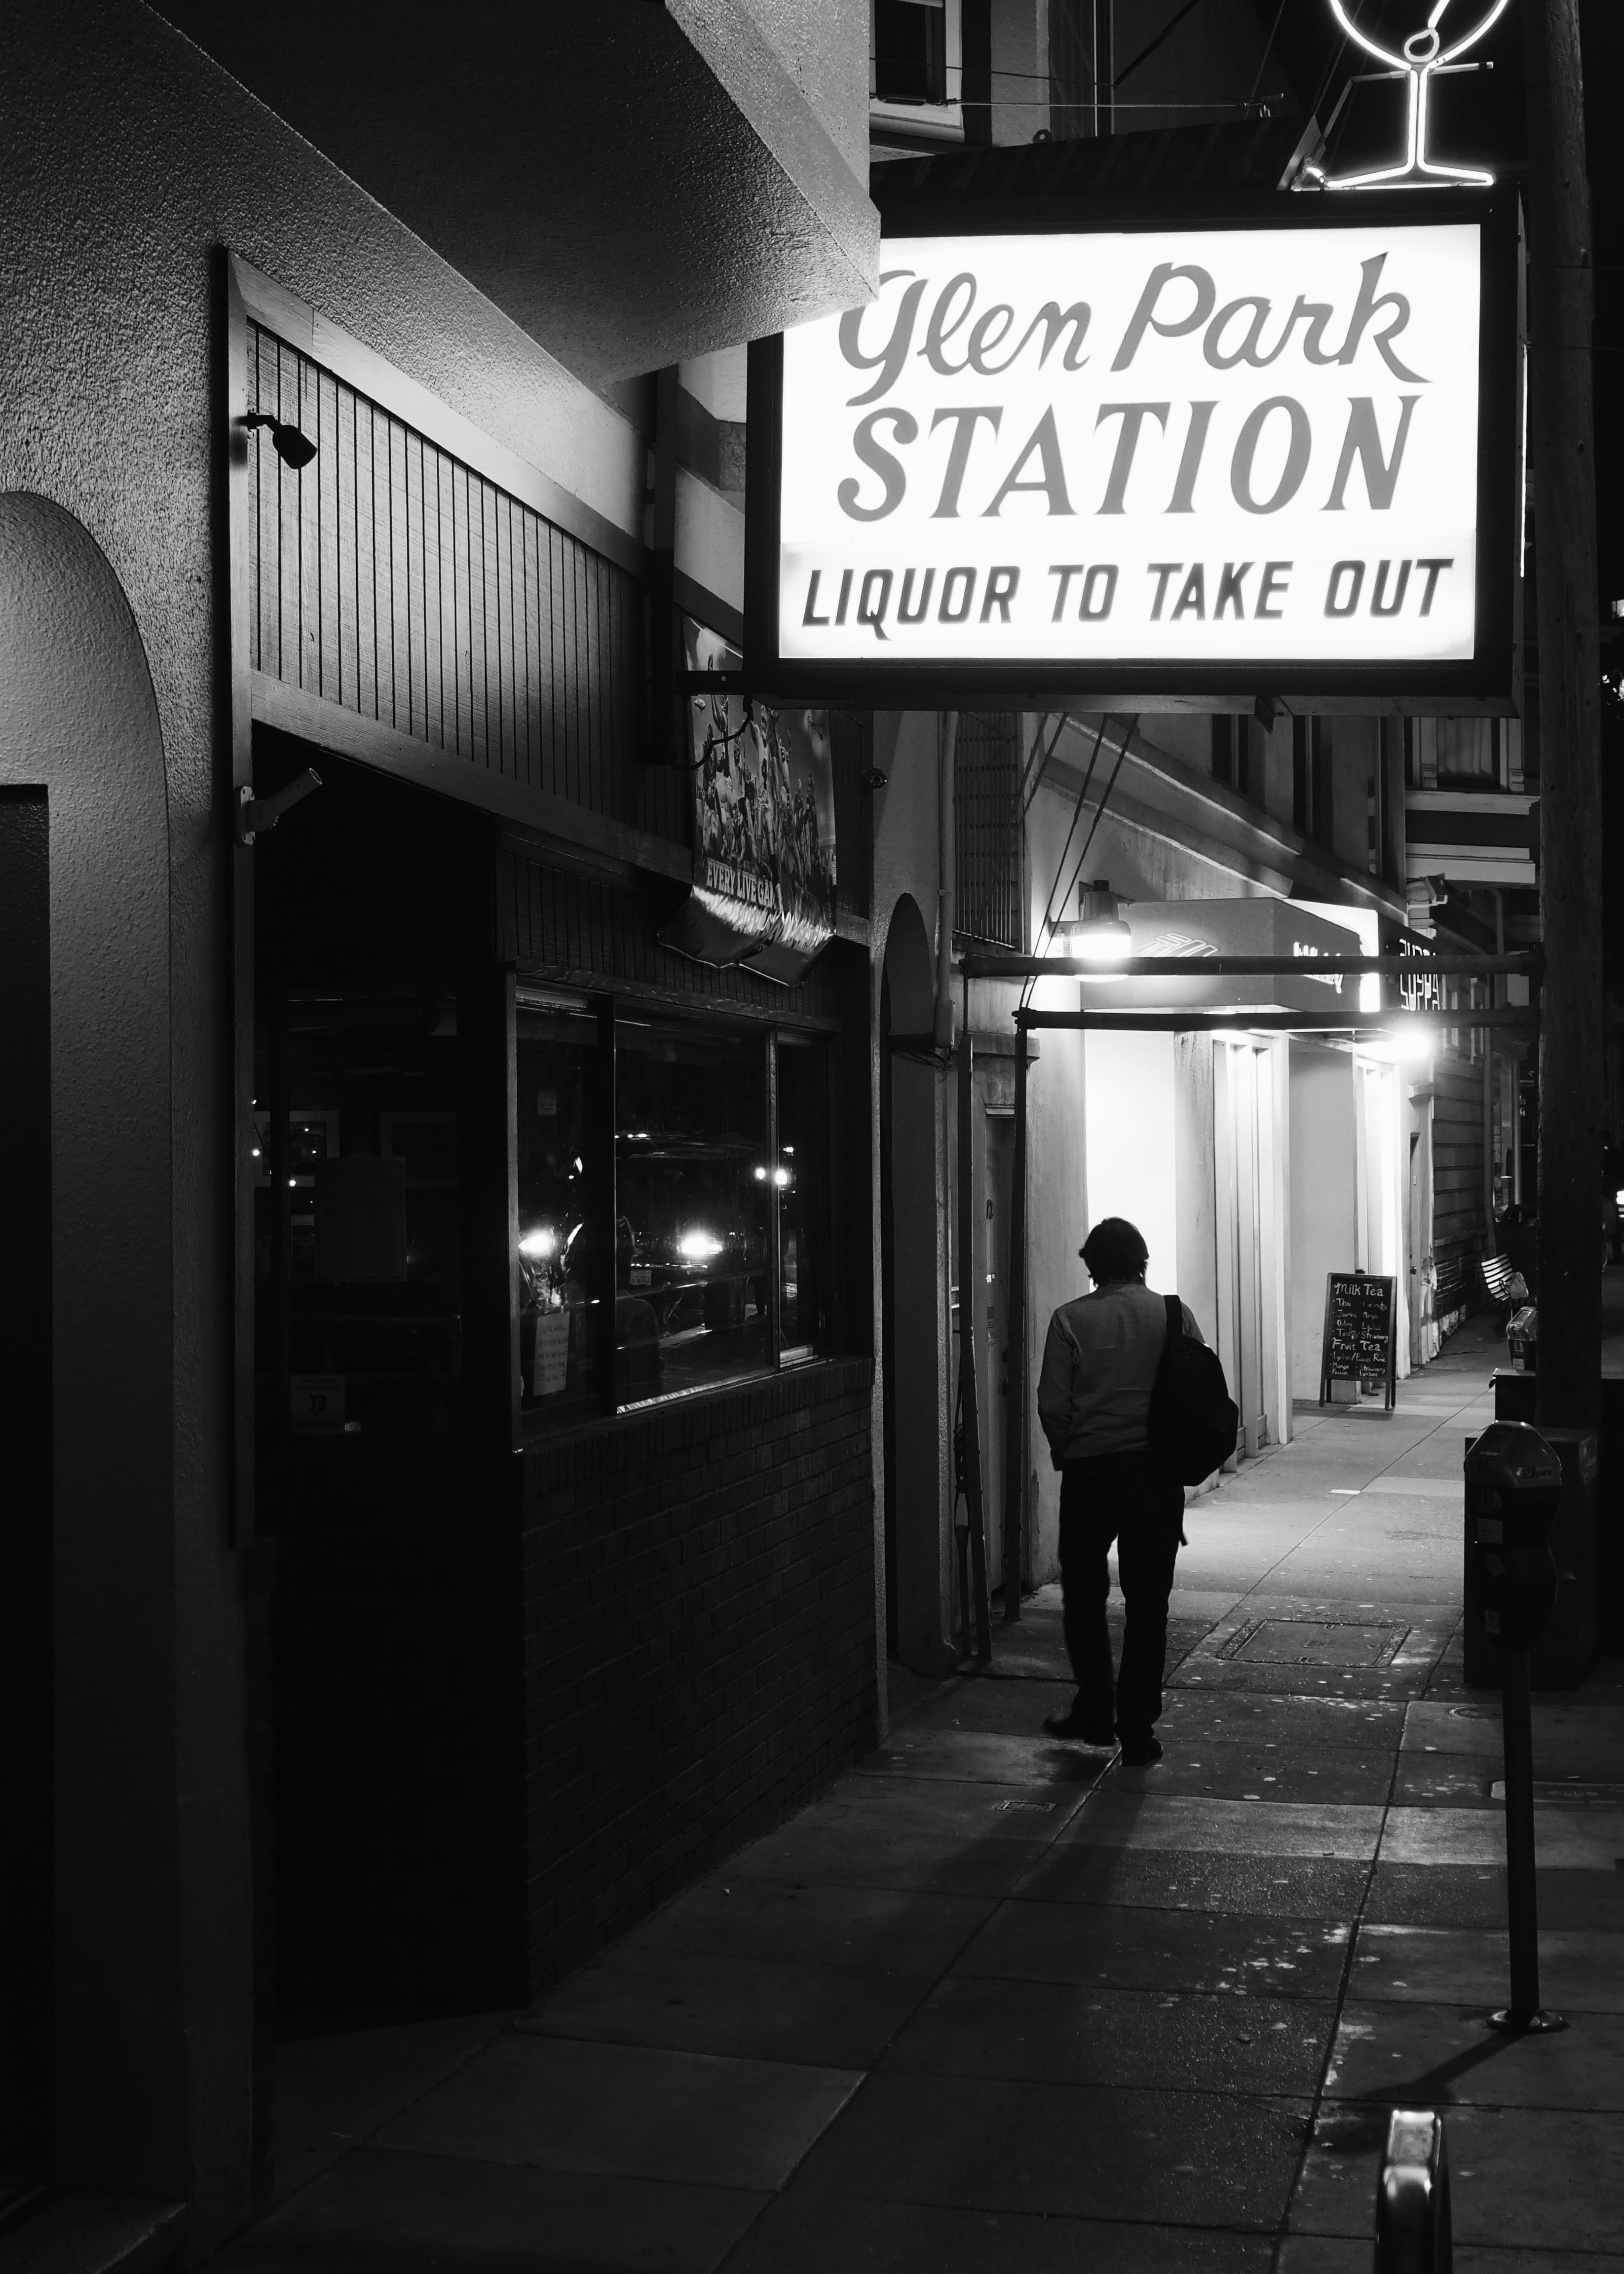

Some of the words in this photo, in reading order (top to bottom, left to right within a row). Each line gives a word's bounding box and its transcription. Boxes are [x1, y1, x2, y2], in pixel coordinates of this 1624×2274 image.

[837, 269, 1092, 407] Glen
[1109, 251, 1434, 383] Park
[836, 395, 1423, 523] STATION
[802, 566, 1021, 641] LIQUOR
[1047, 564, 1120, 622] TO
[1146, 561, 1294, 622] TAKE
[1323, 558, 1454, 618] OUT
[706, 857, 736, 895] EVERY
[737, 869, 757, 903] LIVE
[1334, 1282, 1361, 1295] Milk
[1363, 1283, 1384, 1297] Tea
[1331, 1337, 1357, 1351] Fruit
[1360, 1340, 1382, 1351] Tea
